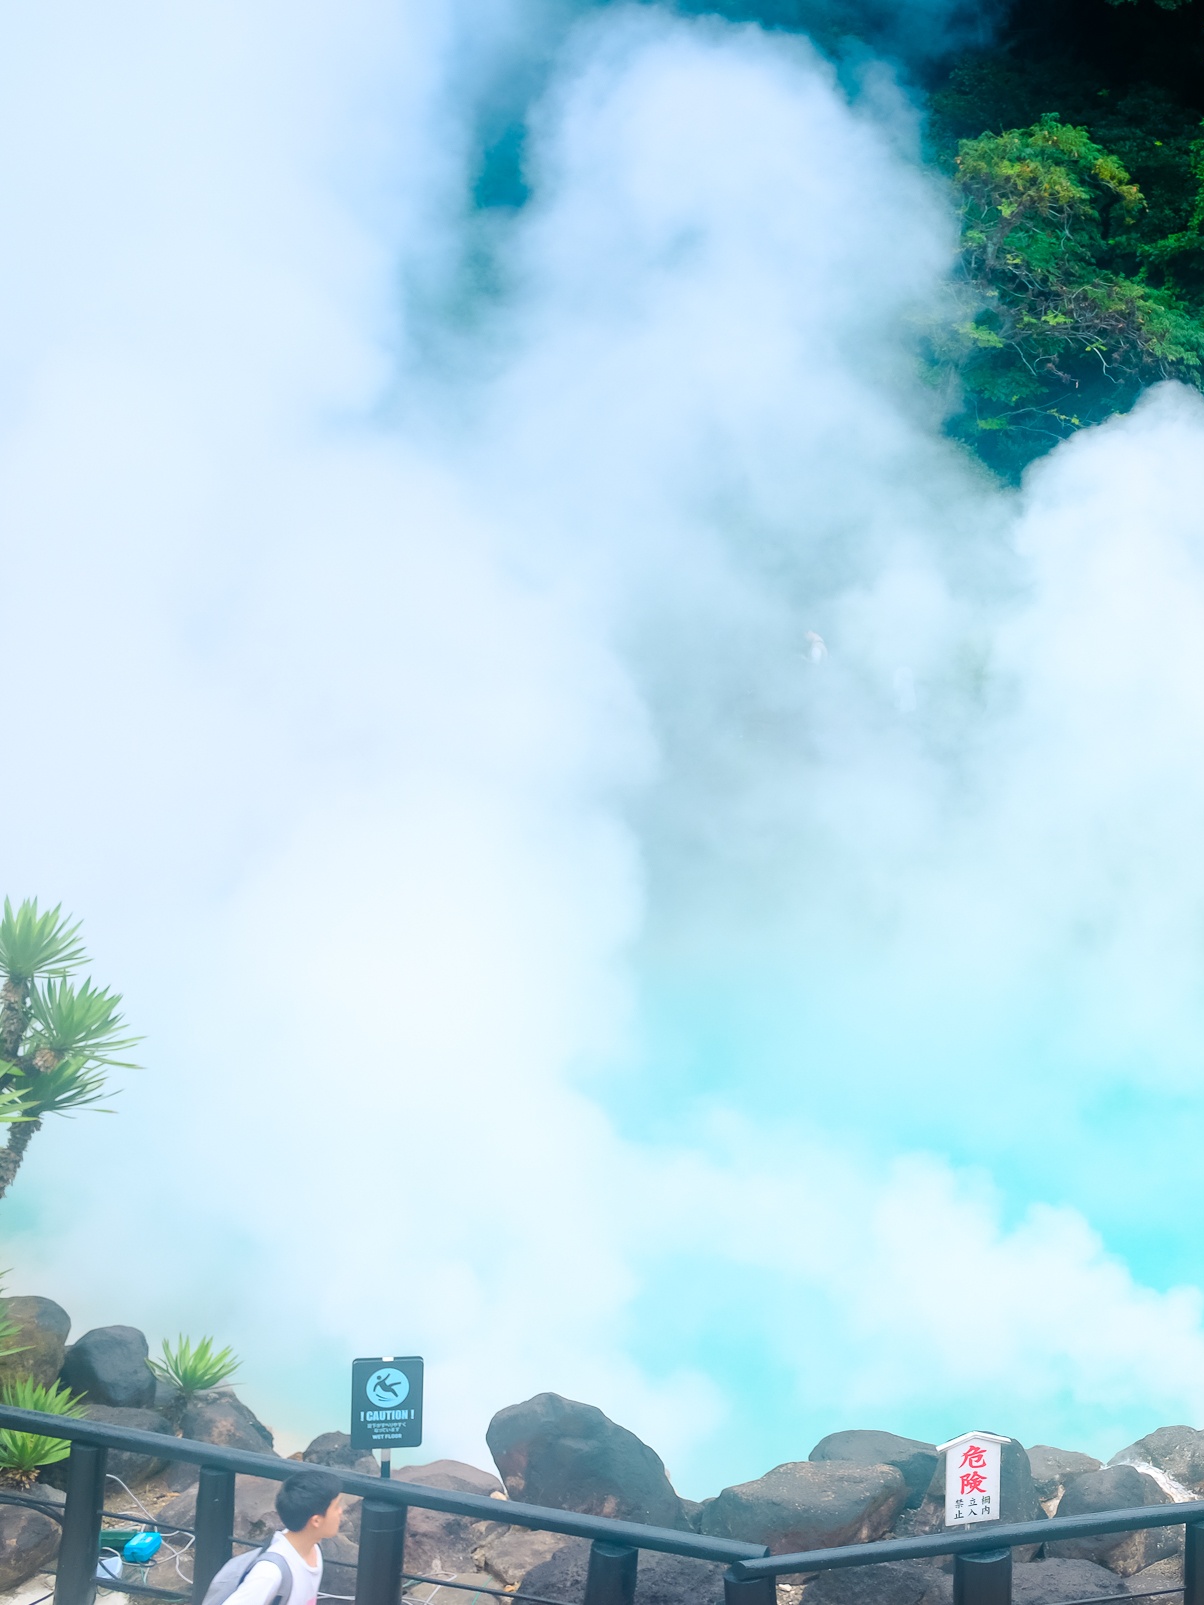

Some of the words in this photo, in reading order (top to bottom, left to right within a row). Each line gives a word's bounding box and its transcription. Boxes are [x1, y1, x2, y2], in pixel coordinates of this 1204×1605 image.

[366, 1409, 408, 1421] CAUTION
[958, 1445, 987, 1495] 危険
[954, 1499, 964, 1519] 禁止
[968, 1498, 978, 1516] 立入
